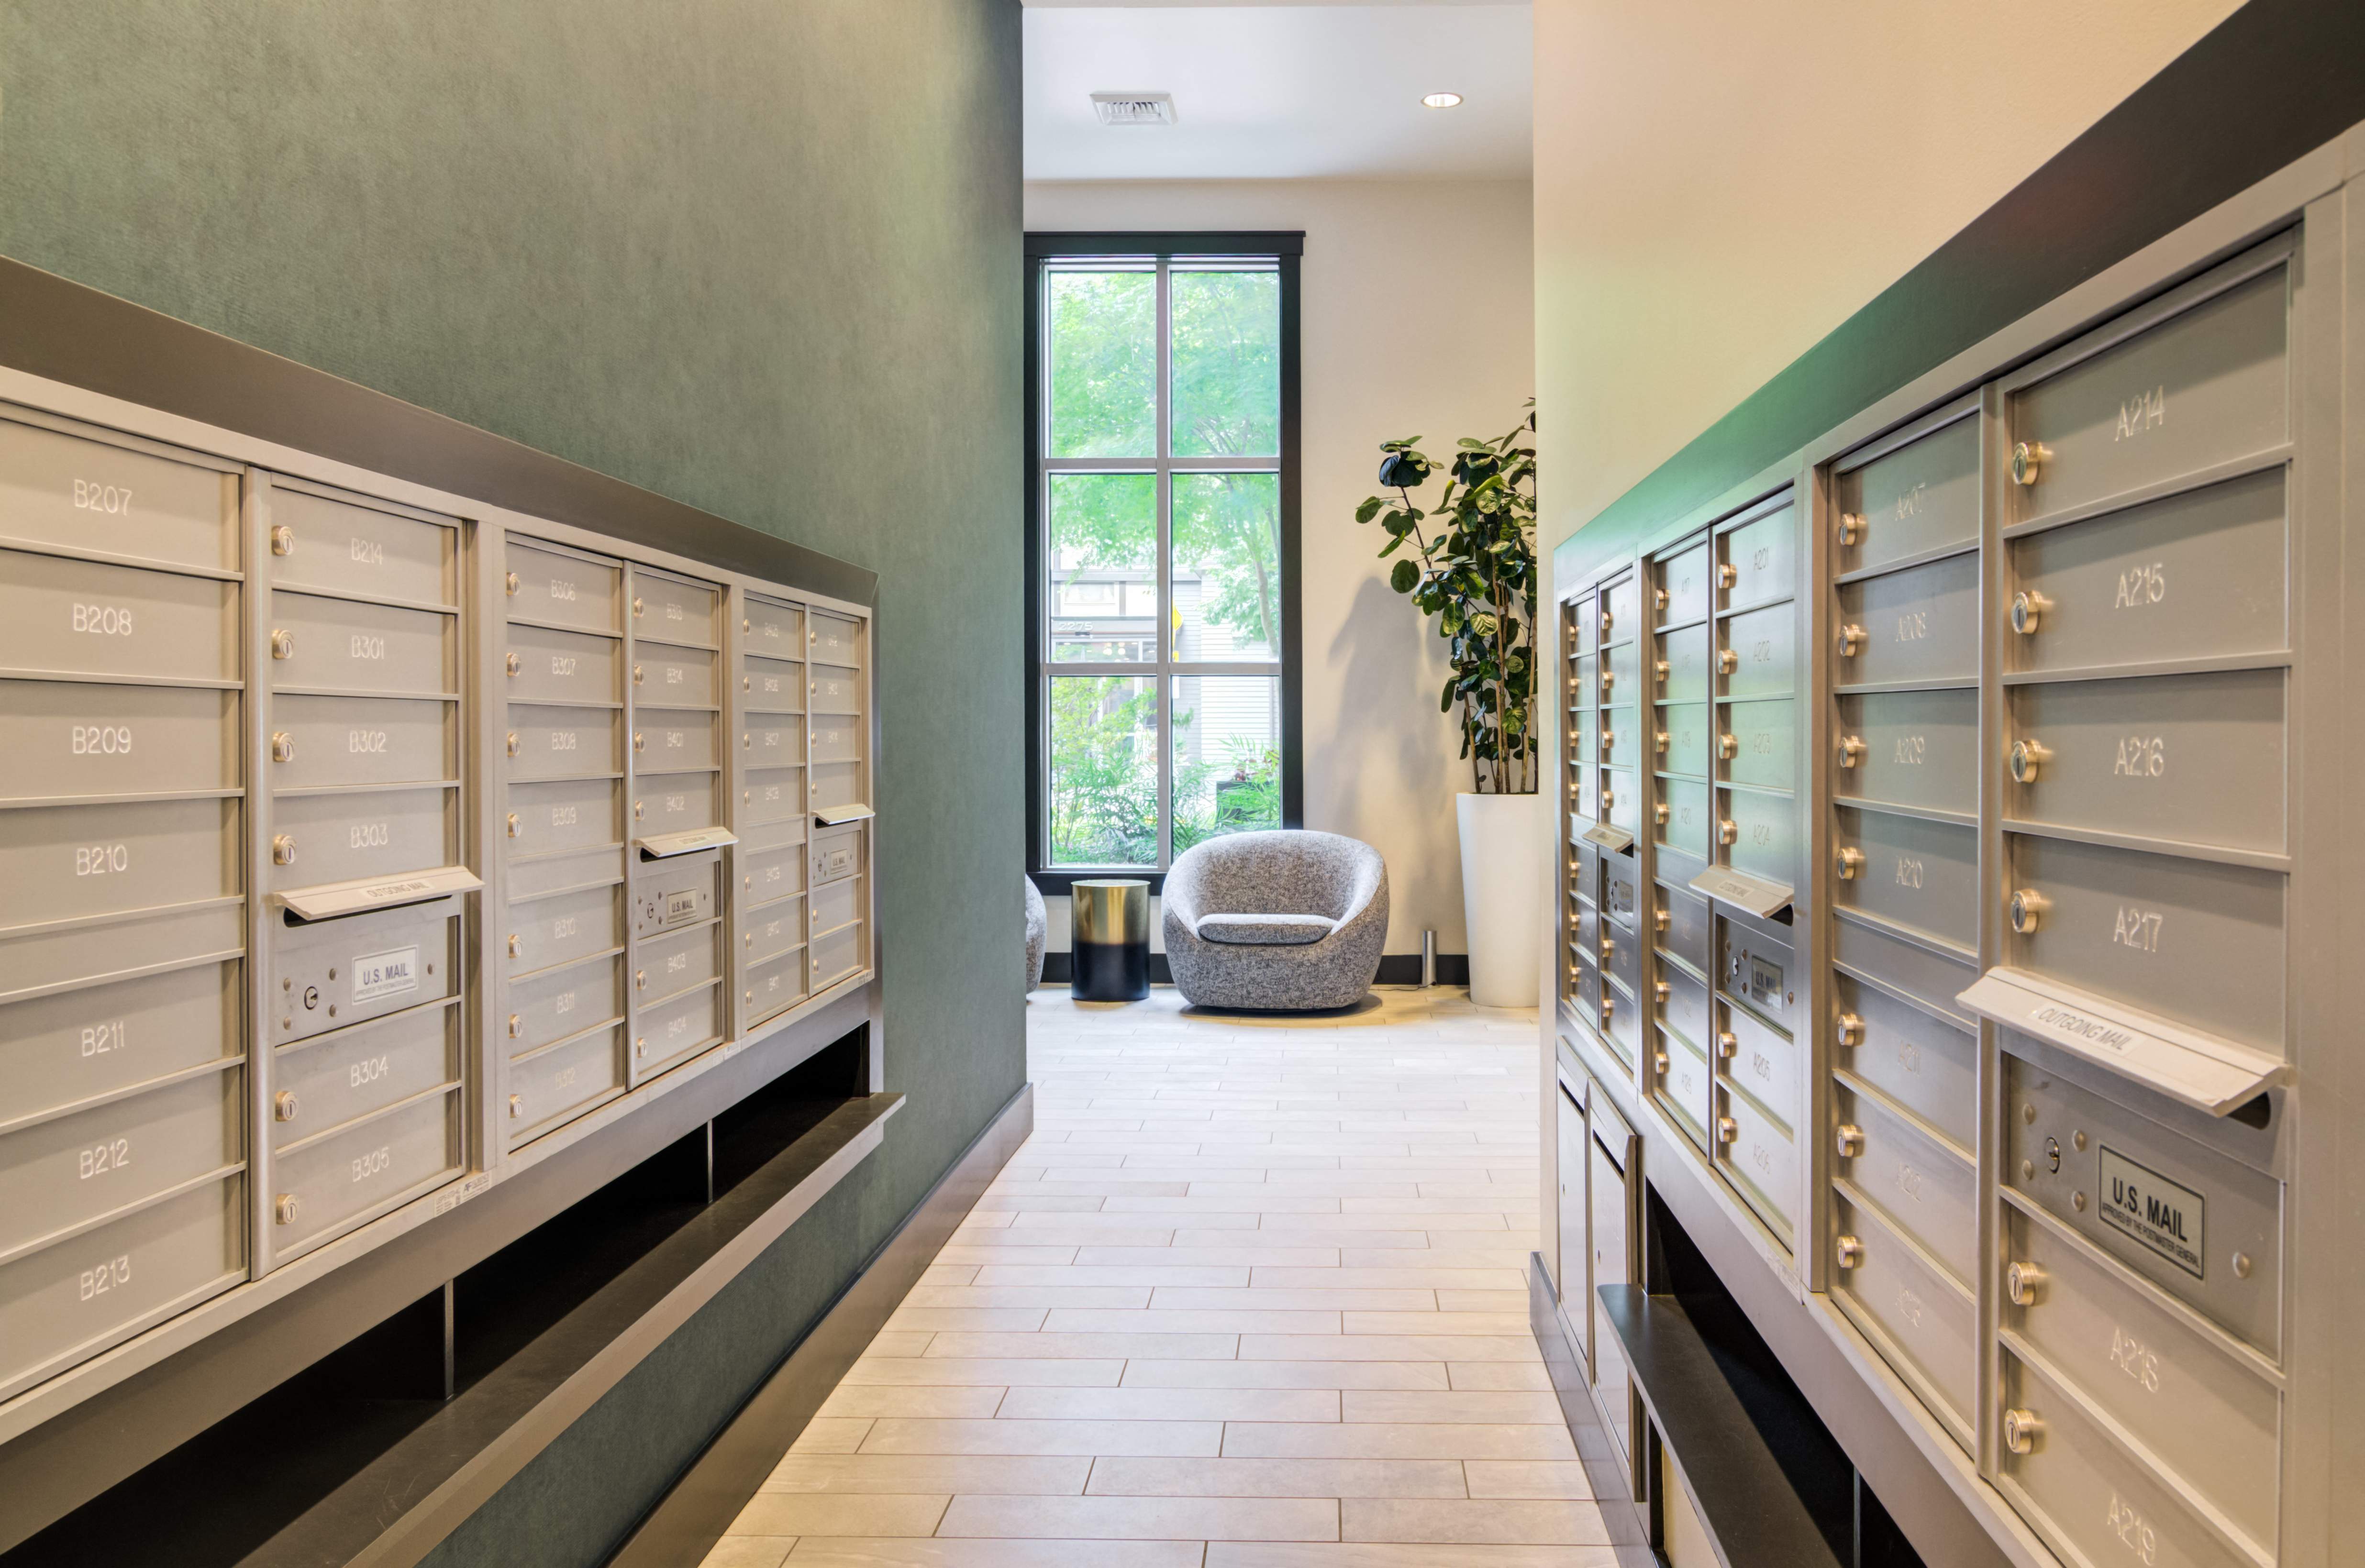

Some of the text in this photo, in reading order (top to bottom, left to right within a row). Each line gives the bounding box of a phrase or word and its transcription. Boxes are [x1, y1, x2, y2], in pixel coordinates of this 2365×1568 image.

[2115, 386, 2165, 442] A214
[74, 479, 133, 516] B207
[351, 538, 384, 565] B214
[1753, 547, 1769, 571] A201
[551, 579, 576, 601] B306
[2115, 563, 2165, 609] A215
[73, 603, 133, 636] B208
[1058, 622, 1093, 631] 2275
[351, 635, 385, 660] B301
[552, 657, 577, 676] B307
[72, 726, 132, 754] B209
[349, 730, 387, 753] B302
[551, 732, 577, 750] B308
[1895, 735, 1925, 765] A209
[2114, 737, 2165, 777] A216
[553, 807, 577, 826] B309
[350, 823, 389, 849] B303
[77, 845, 128, 876] B210
[1896, 856, 1923, 889] A210
[671, 898, 694, 913] U.S. MAIL
[555, 918, 576, 939] B310
[2114, 905, 2164, 953] A217
[363, 962, 409, 985] U.S. MAIL
[556, 992, 575, 1014] B311
[81, 1021, 126, 1057] B211
[2038, 1008, 2132, 1050] OUTGOING MAIL
[351, 1056, 389, 1087] B304
[555, 1068, 576, 1091] B312
[79, 1139, 130, 1180] B212
[352, 1147, 389, 1182] B305
[2113, 1176, 2188, 1243] U.S. MAIL
[80, 1255, 131, 1301] B213
[2109, 1325, 2159, 1393] A218
[2107, 1493, 2156, 1567] A219
